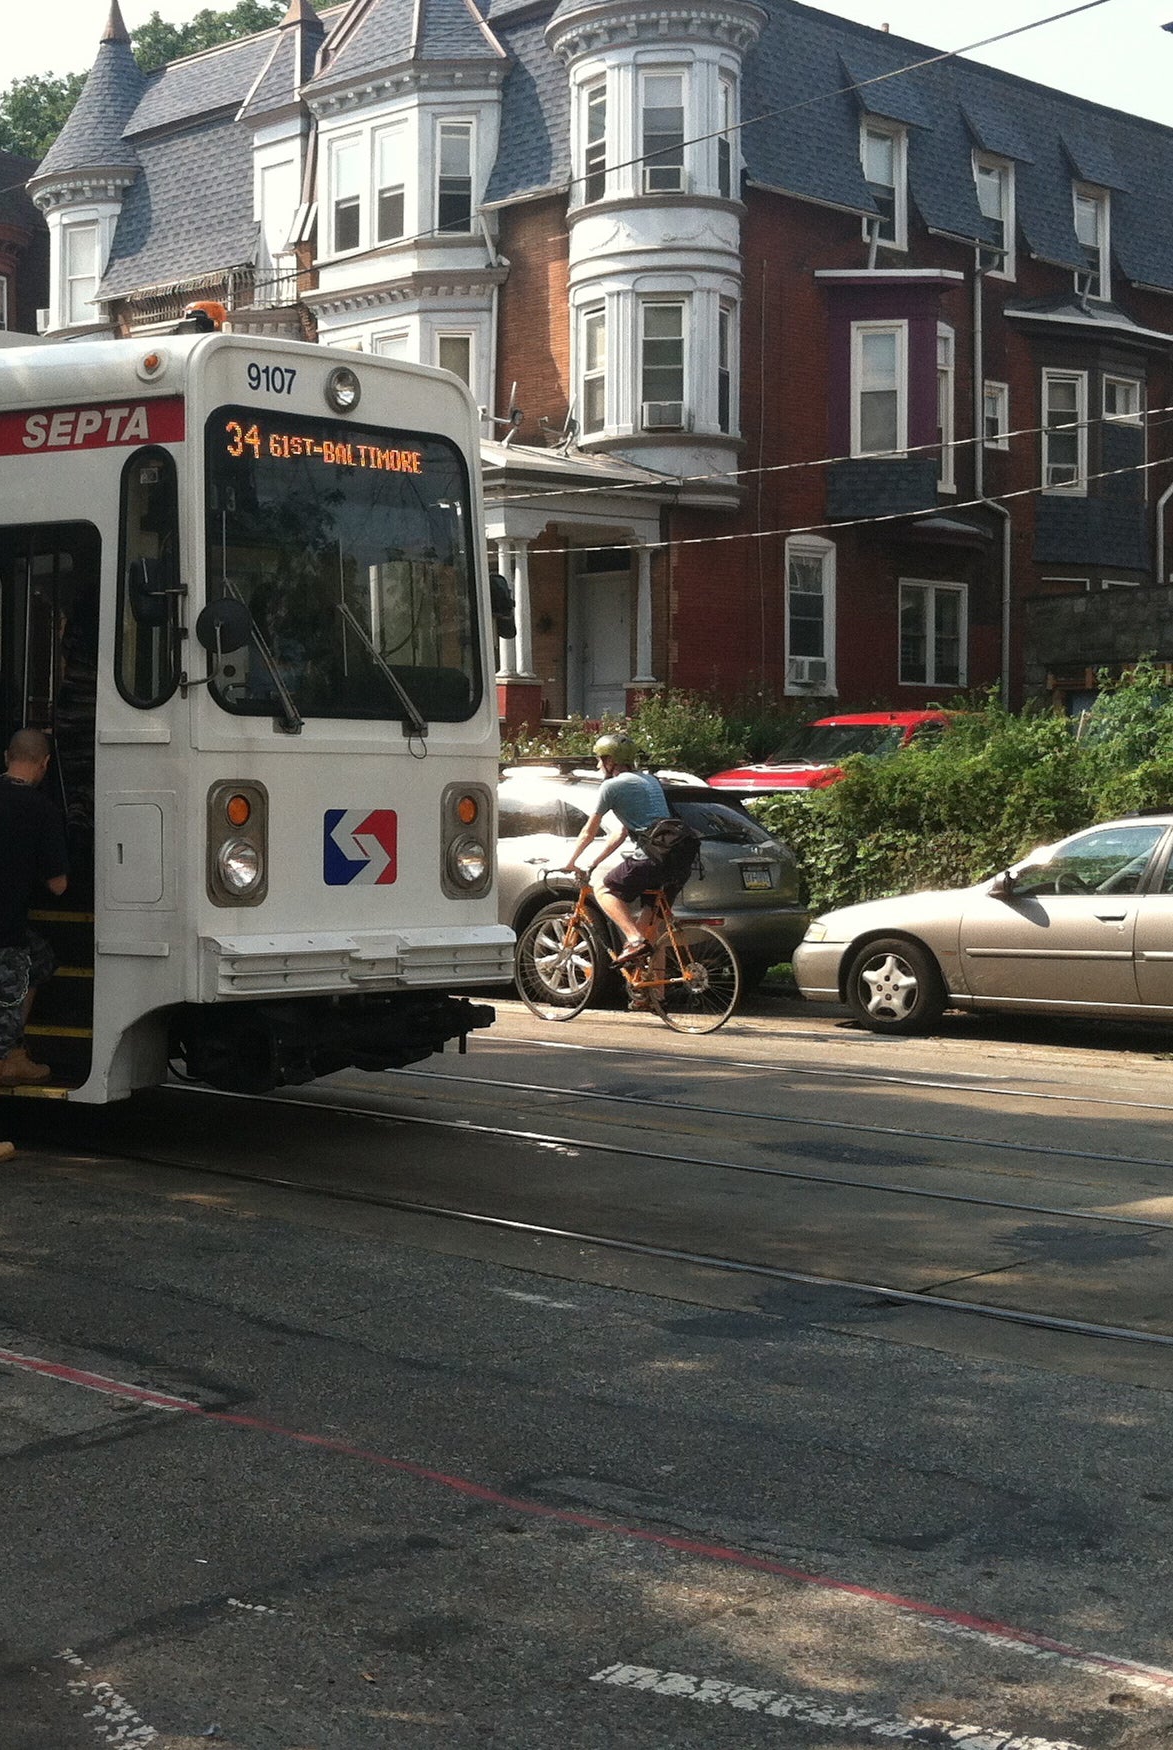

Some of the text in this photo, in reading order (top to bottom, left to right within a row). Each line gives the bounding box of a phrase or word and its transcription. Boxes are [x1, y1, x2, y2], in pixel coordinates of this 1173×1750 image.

[247, 362, 297, 395] 9107
[22, 406, 150, 449] SEPTA
[225, 421, 423, 475] 34 61ST-BALTIMORE
